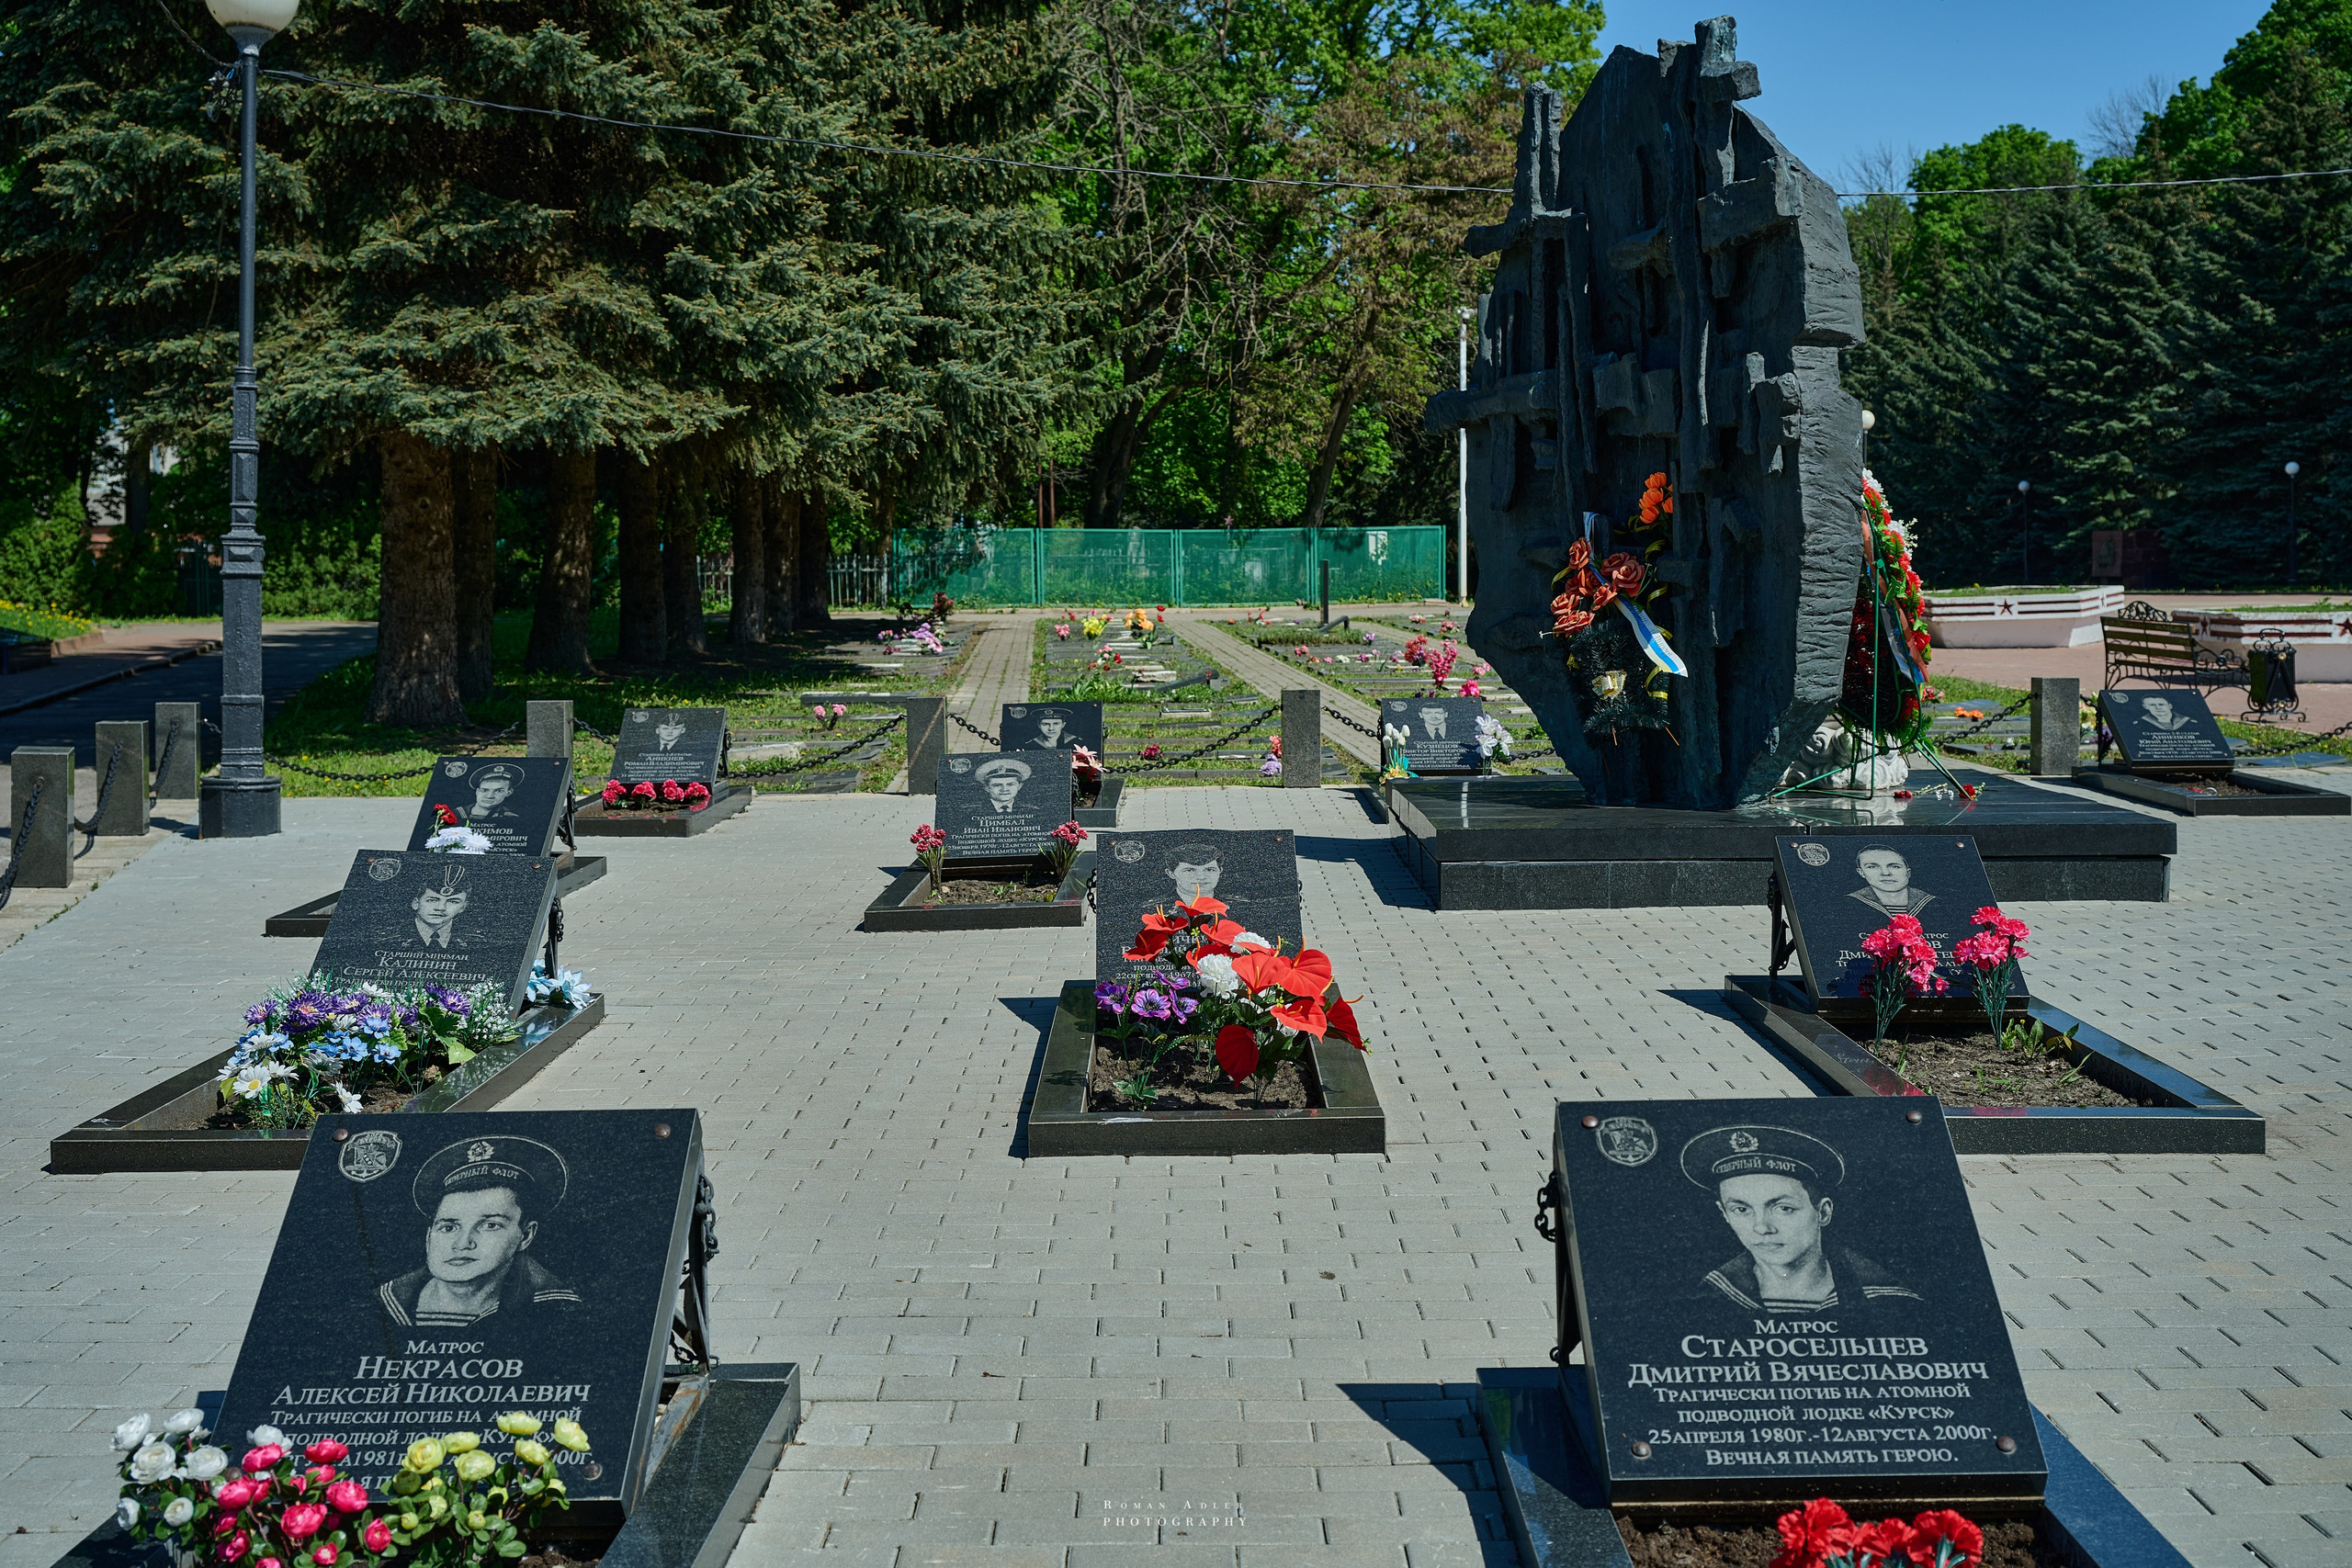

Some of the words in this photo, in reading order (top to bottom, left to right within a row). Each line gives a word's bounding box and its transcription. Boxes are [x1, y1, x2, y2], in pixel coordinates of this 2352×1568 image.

[379, 957, 457, 970] КАЛИНИН
[1754, 1319, 1838, 1335] МАТРОС
[405, 1340, 483, 1355] МАТРОС
[1680, 1335, 1928, 1359] СТАРОСЕЛЬЦЕВ
[353, 1356, 524, 1379] НЕКРАСОВ
[1628, 1361, 1759, 1388] ДМИТРИЙ
[1770, 1361, 1989, 1383] ВЯЧЕСЛАВОВИЧ
[270, 1382, 400, 1405] АЛЕКСЕЙ
[404, 1384, 591, 1404] НИКОЛАЕВИЧ
[1654, 1387, 1775, 1403] ТРАГИЧЕСКИ
[1781, 1387, 1840, 1401] ПОГИБ
[1845, 1387, 1871, 1400] НА
[1877, 1382, 1971, 1399] АТОМНОЙ
[271, 1410, 390, 1425] ТРАГИЧЕСКИ
[392, 1411, 452, 1424] ПОГИБ
[456, 1411, 481, 1423] НА
[1678, 1404, 1795, 1425] ПОДВОДНОЙ
[1802, 1405, 1864, 1423] ЛОДКЕ
[1706, 1449, 1792, 1466] ВЕЧНАЯ
[1794, 1448, 1878, 1464] ПАМЯТЬ
